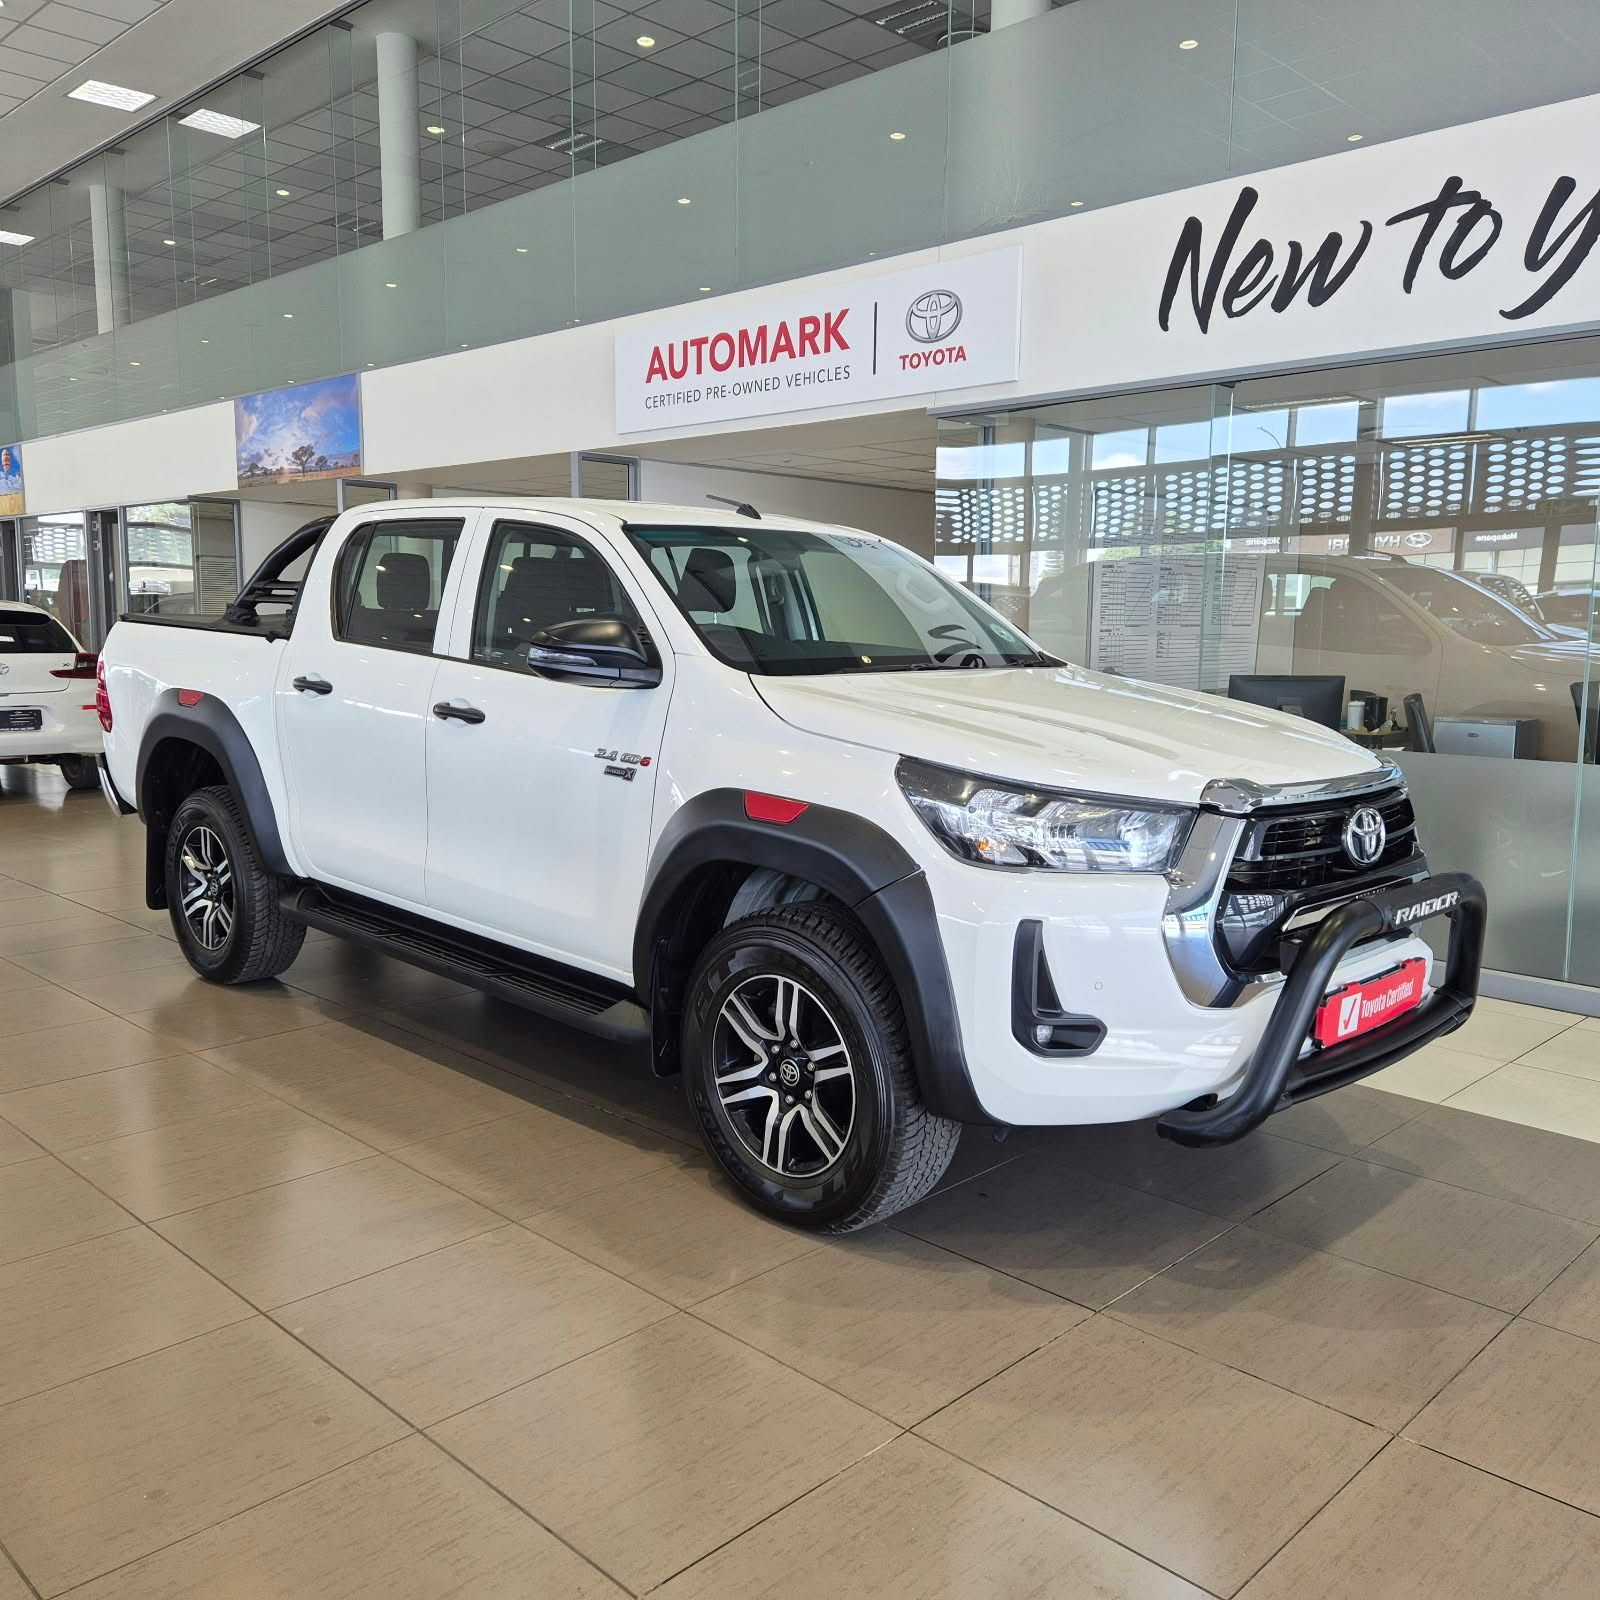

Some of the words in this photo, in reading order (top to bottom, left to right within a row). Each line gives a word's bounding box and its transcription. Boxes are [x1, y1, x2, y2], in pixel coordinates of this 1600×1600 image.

[1158, 186, 1373, 334] New
[645, 308, 850, 384] AUTOMARK
[899, 345, 967, 371] TOYOTA
[645, 389, 702, 410] CERTIFIED
[706, 376, 781, 400] PRE-OWNED
[785, 364, 851, 388] VEHICLES
[1361, 993, 1387, 1019] Toyota
[1386, 977, 1415, 1008] Certified
